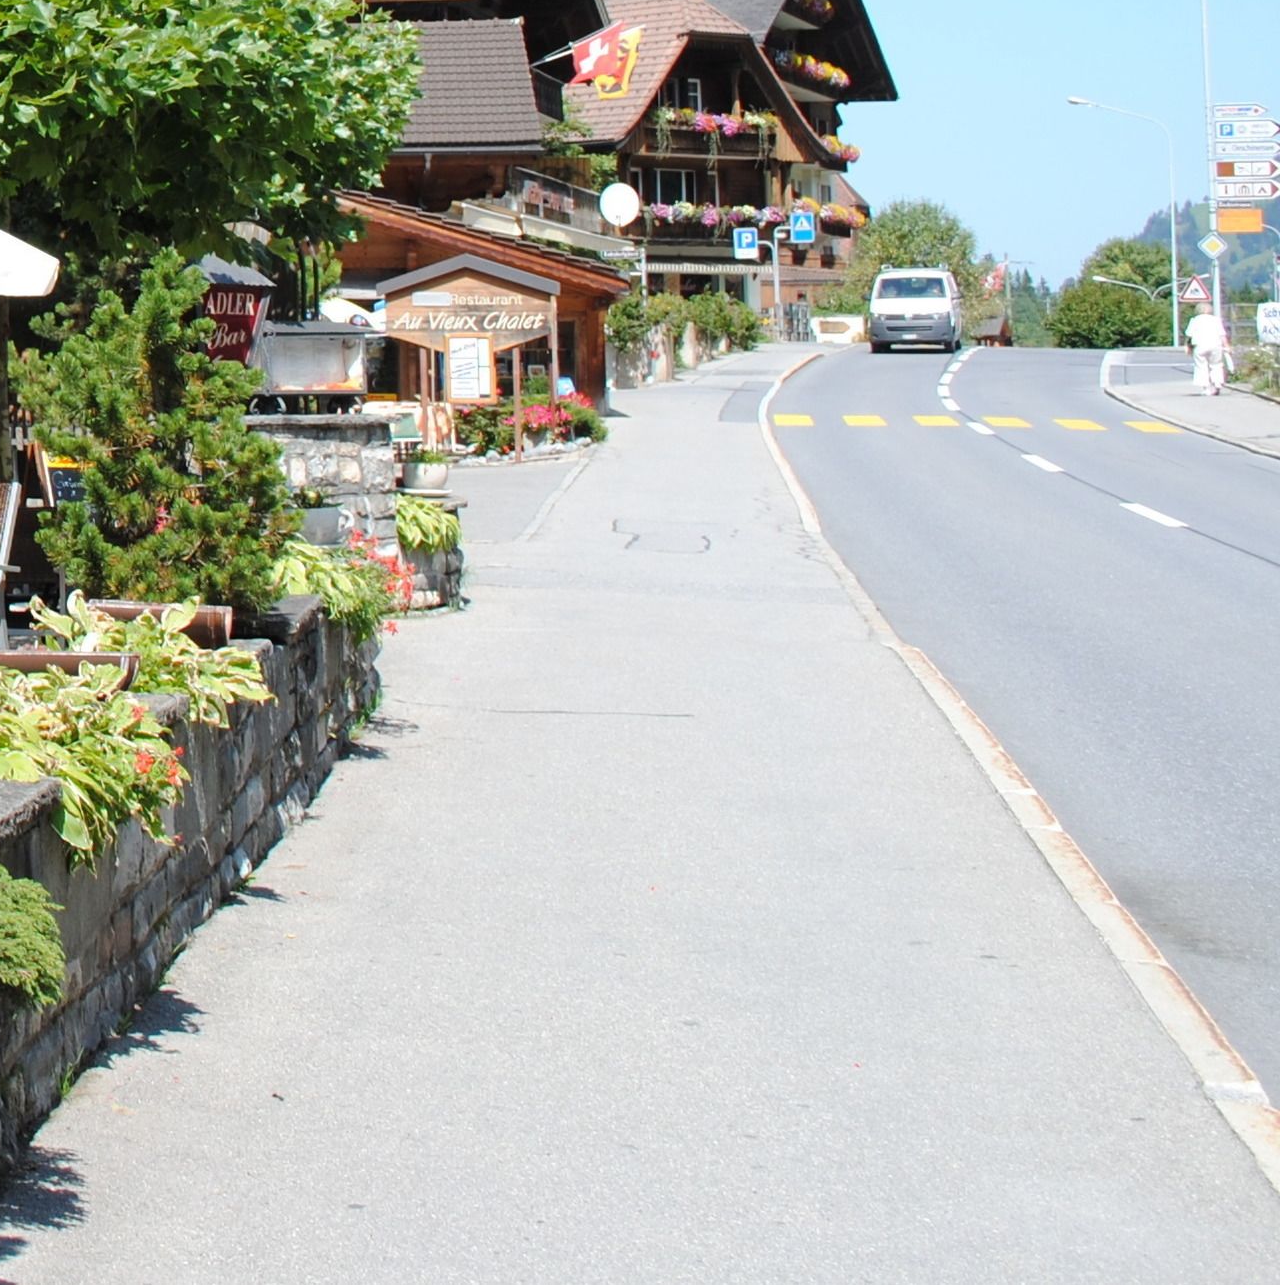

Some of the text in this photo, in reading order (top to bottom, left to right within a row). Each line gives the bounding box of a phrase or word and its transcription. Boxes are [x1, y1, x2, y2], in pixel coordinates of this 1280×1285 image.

[205, 292, 255, 316] ADLER
[450, 293, 523, 306] Restaurant
[393, 311, 545, 331] Au Vieux Chalet
[208, 322, 247, 350] Bar
